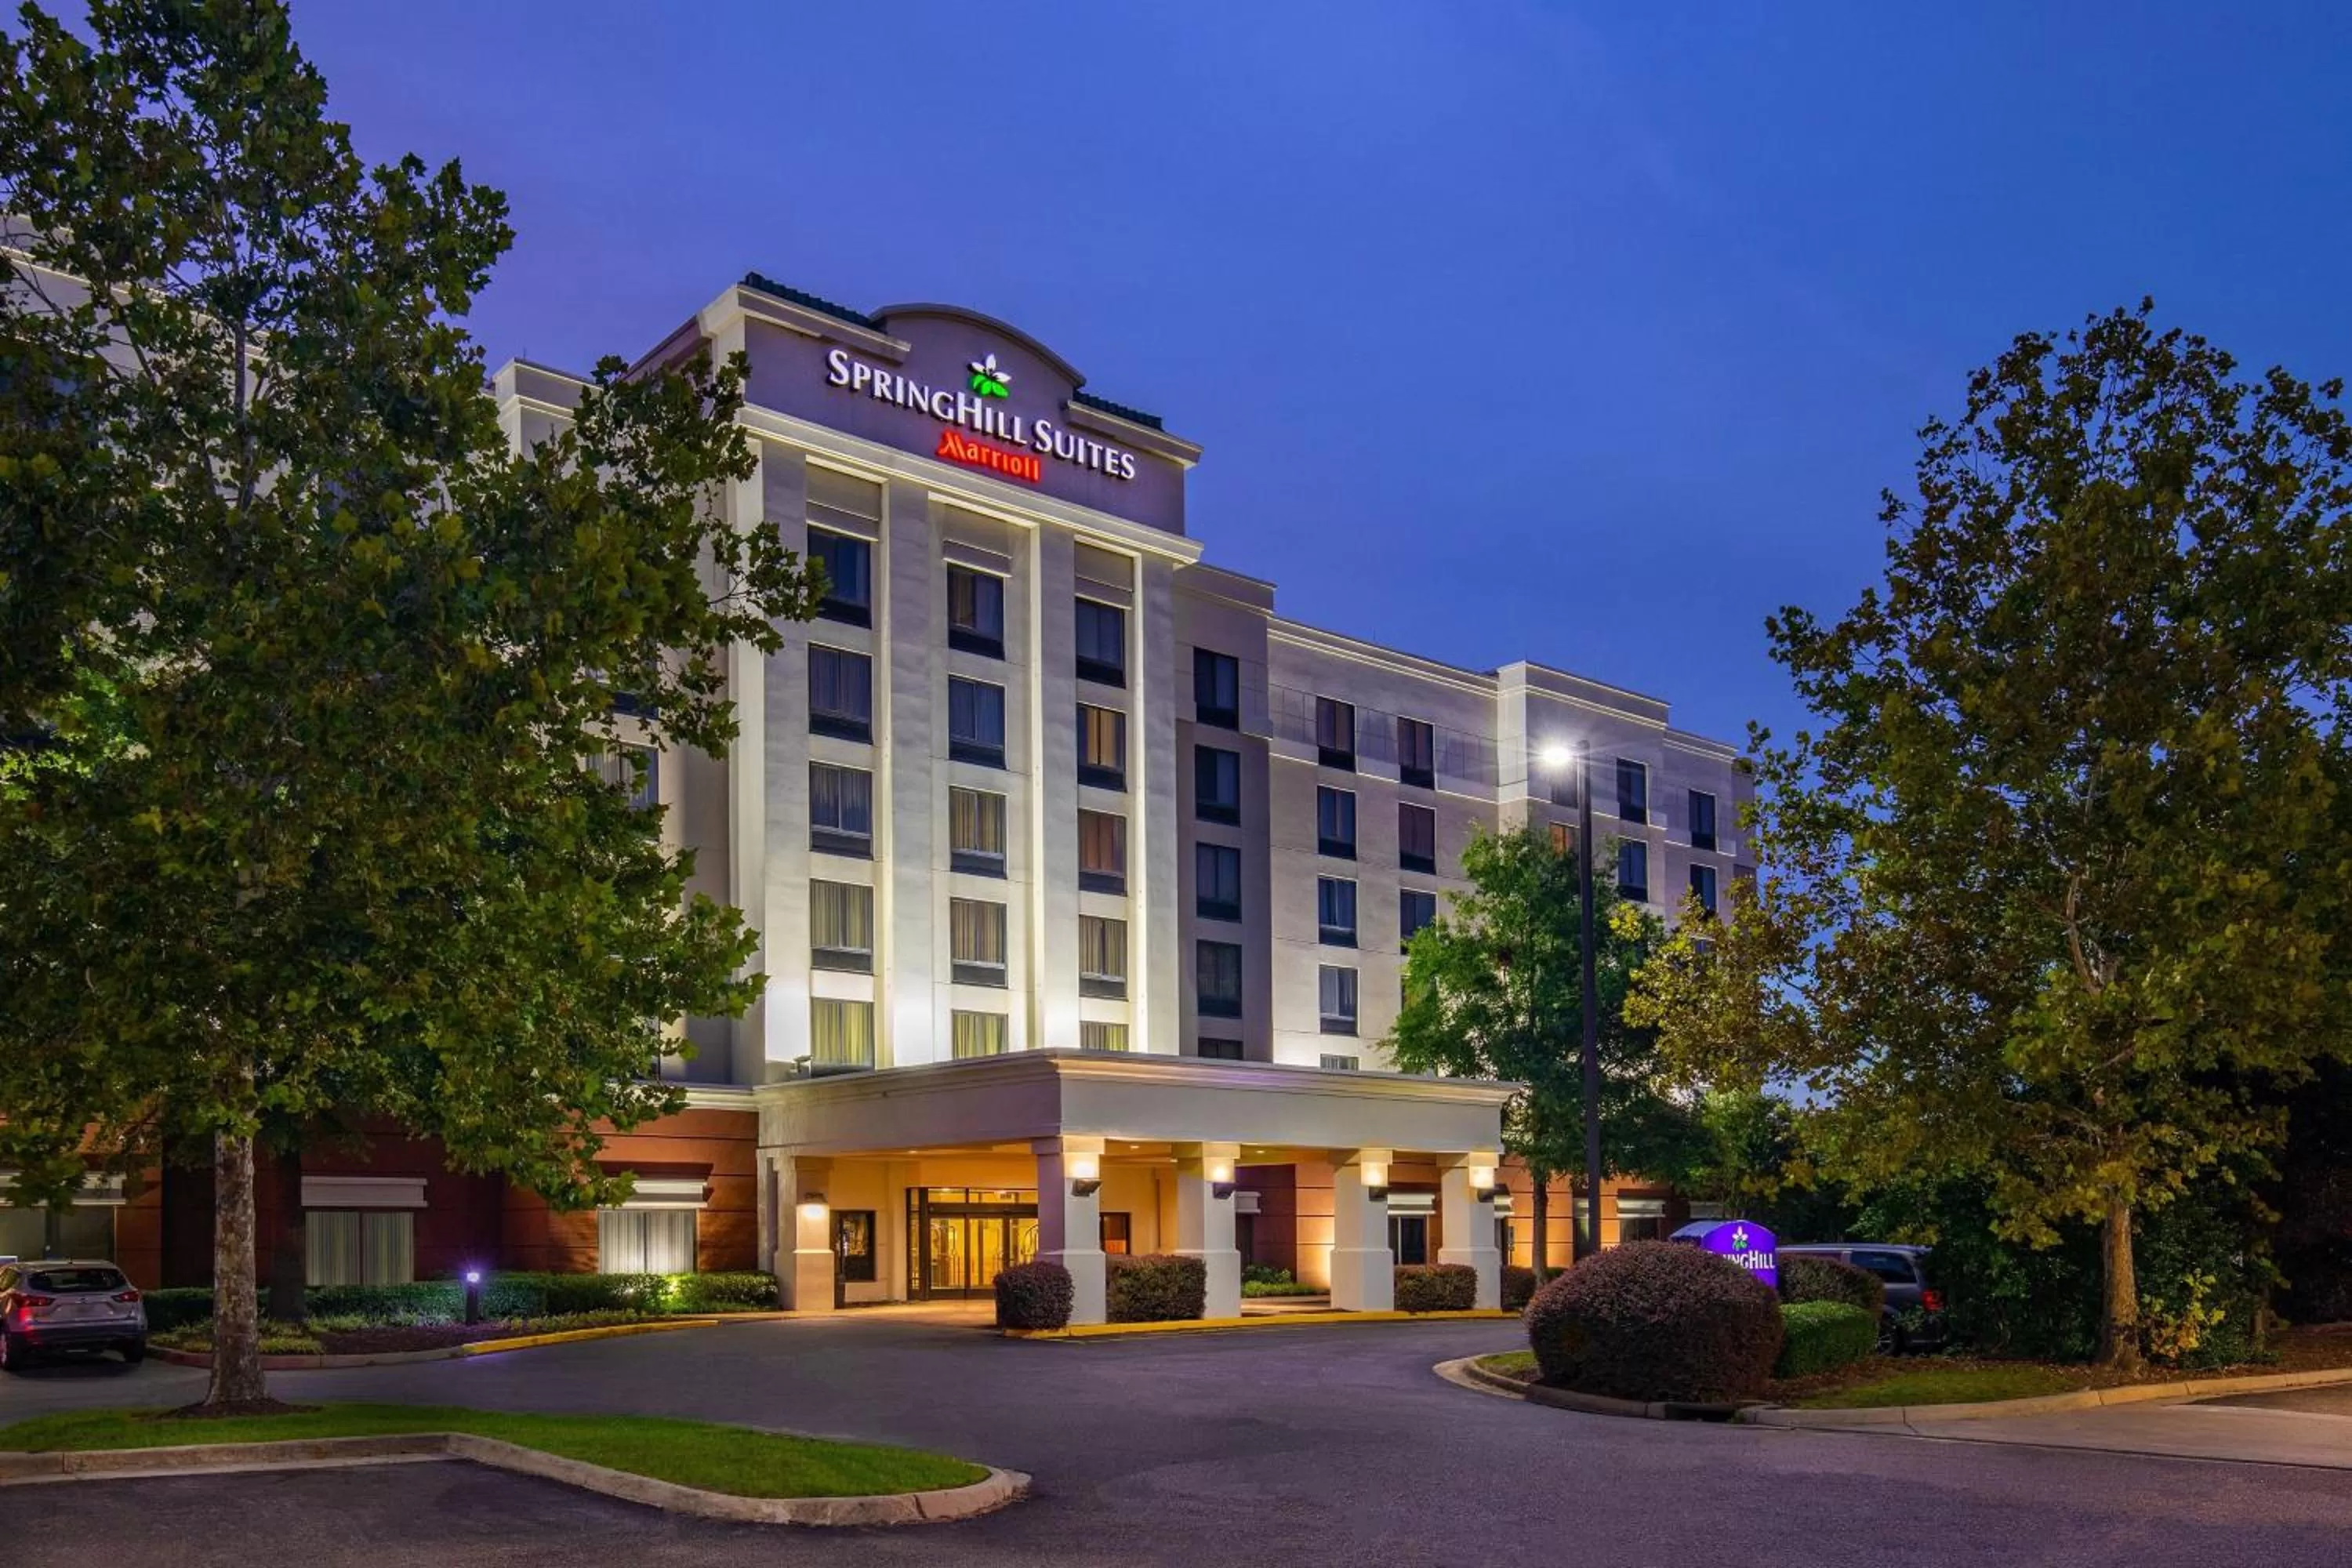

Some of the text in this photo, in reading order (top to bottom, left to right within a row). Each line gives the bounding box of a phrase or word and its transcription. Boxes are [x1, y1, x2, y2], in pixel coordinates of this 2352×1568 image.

[827, 349, 1135, 480] SPRINGHILL SUITES
[938, 430, 1040, 481] Marriott
